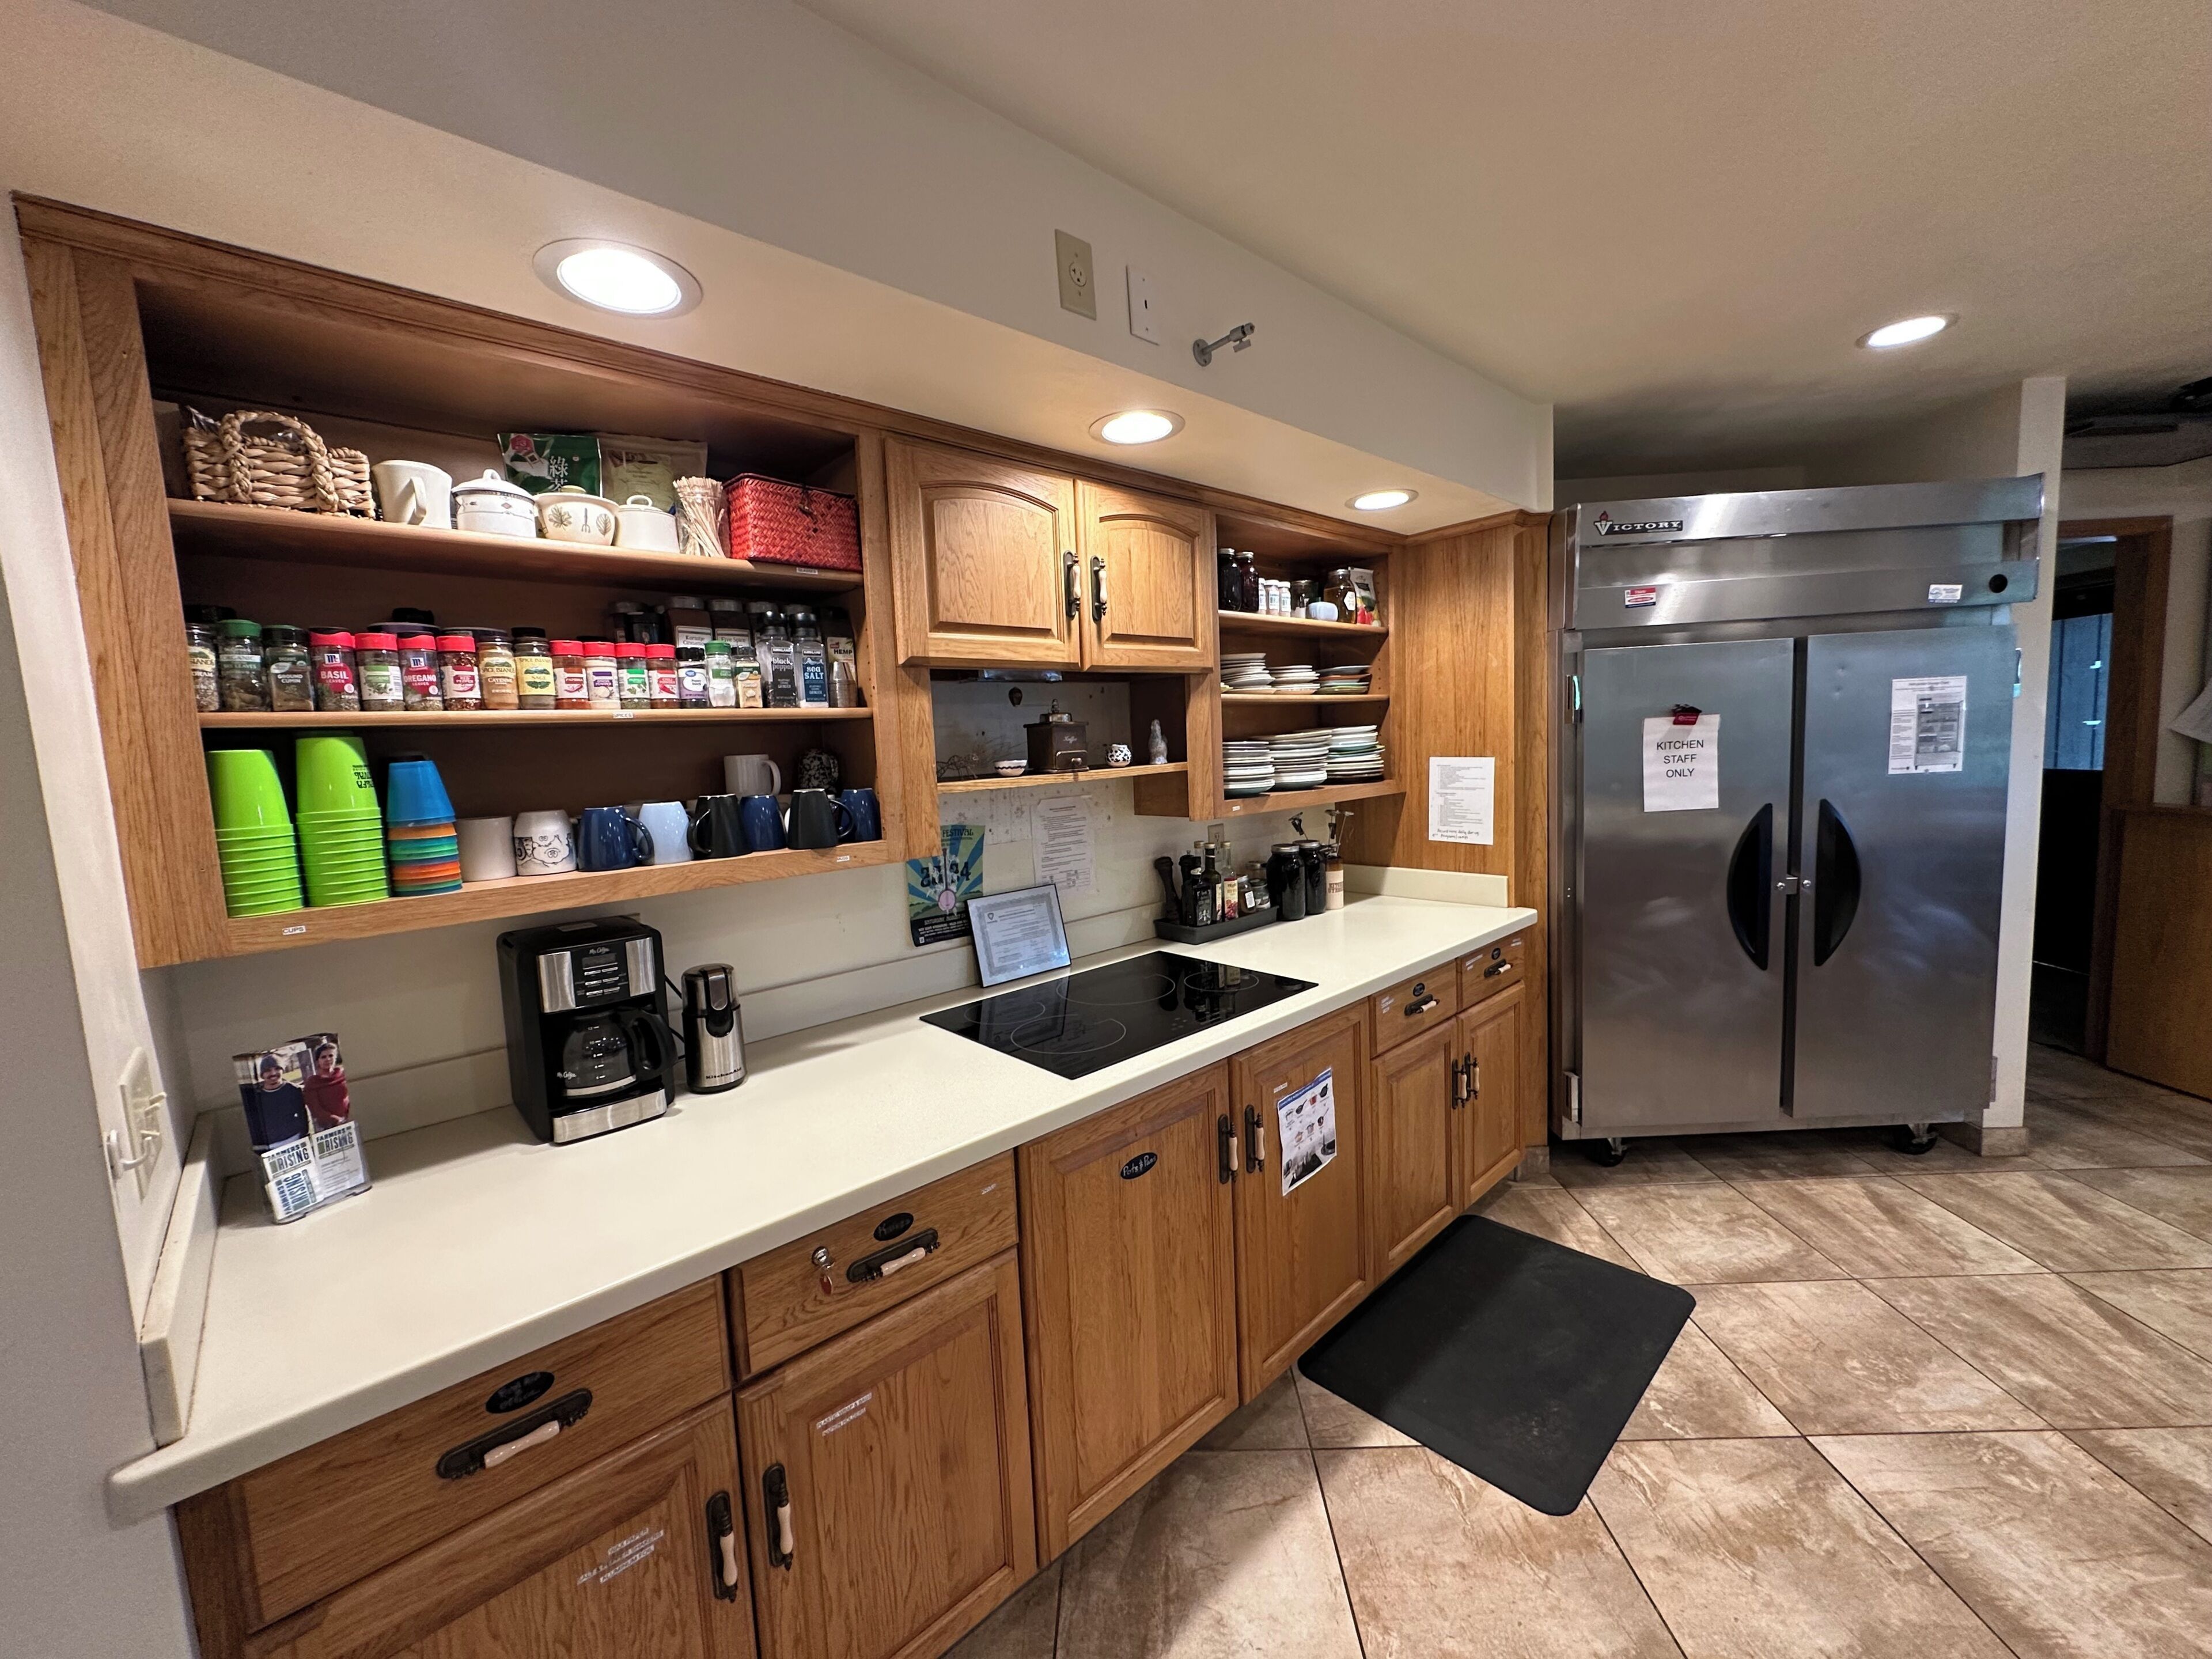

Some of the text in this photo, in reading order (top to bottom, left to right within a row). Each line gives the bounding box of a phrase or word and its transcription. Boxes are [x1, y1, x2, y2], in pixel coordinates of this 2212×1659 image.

[1594, 520, 1681, 535] VICTORY
[772, 657, 793, 665] black
[320, 671, 349, 680] BASIL
[404, 674, 437, 683] OREGANO
[1657, 740, 1704, 751] KITCHEN
[1664, 753, 1698, 764] STAFF
[1666, 768, 1695, 778] ONLY
[942, 829, 974, 838] FESTIVAL
[317, 1127, 346, 1142] FARMERS
[325, 1132, 354, 1152] RISING
[268, 1144, 300, 1161] FARMERS
[277, 1147, 309, 1171] RISING
[1123, 1162, 1138, 1176] Pots
[283, 1172, 309, 1204] RISING
[277, 1185, 293, 1215] FARMERS
